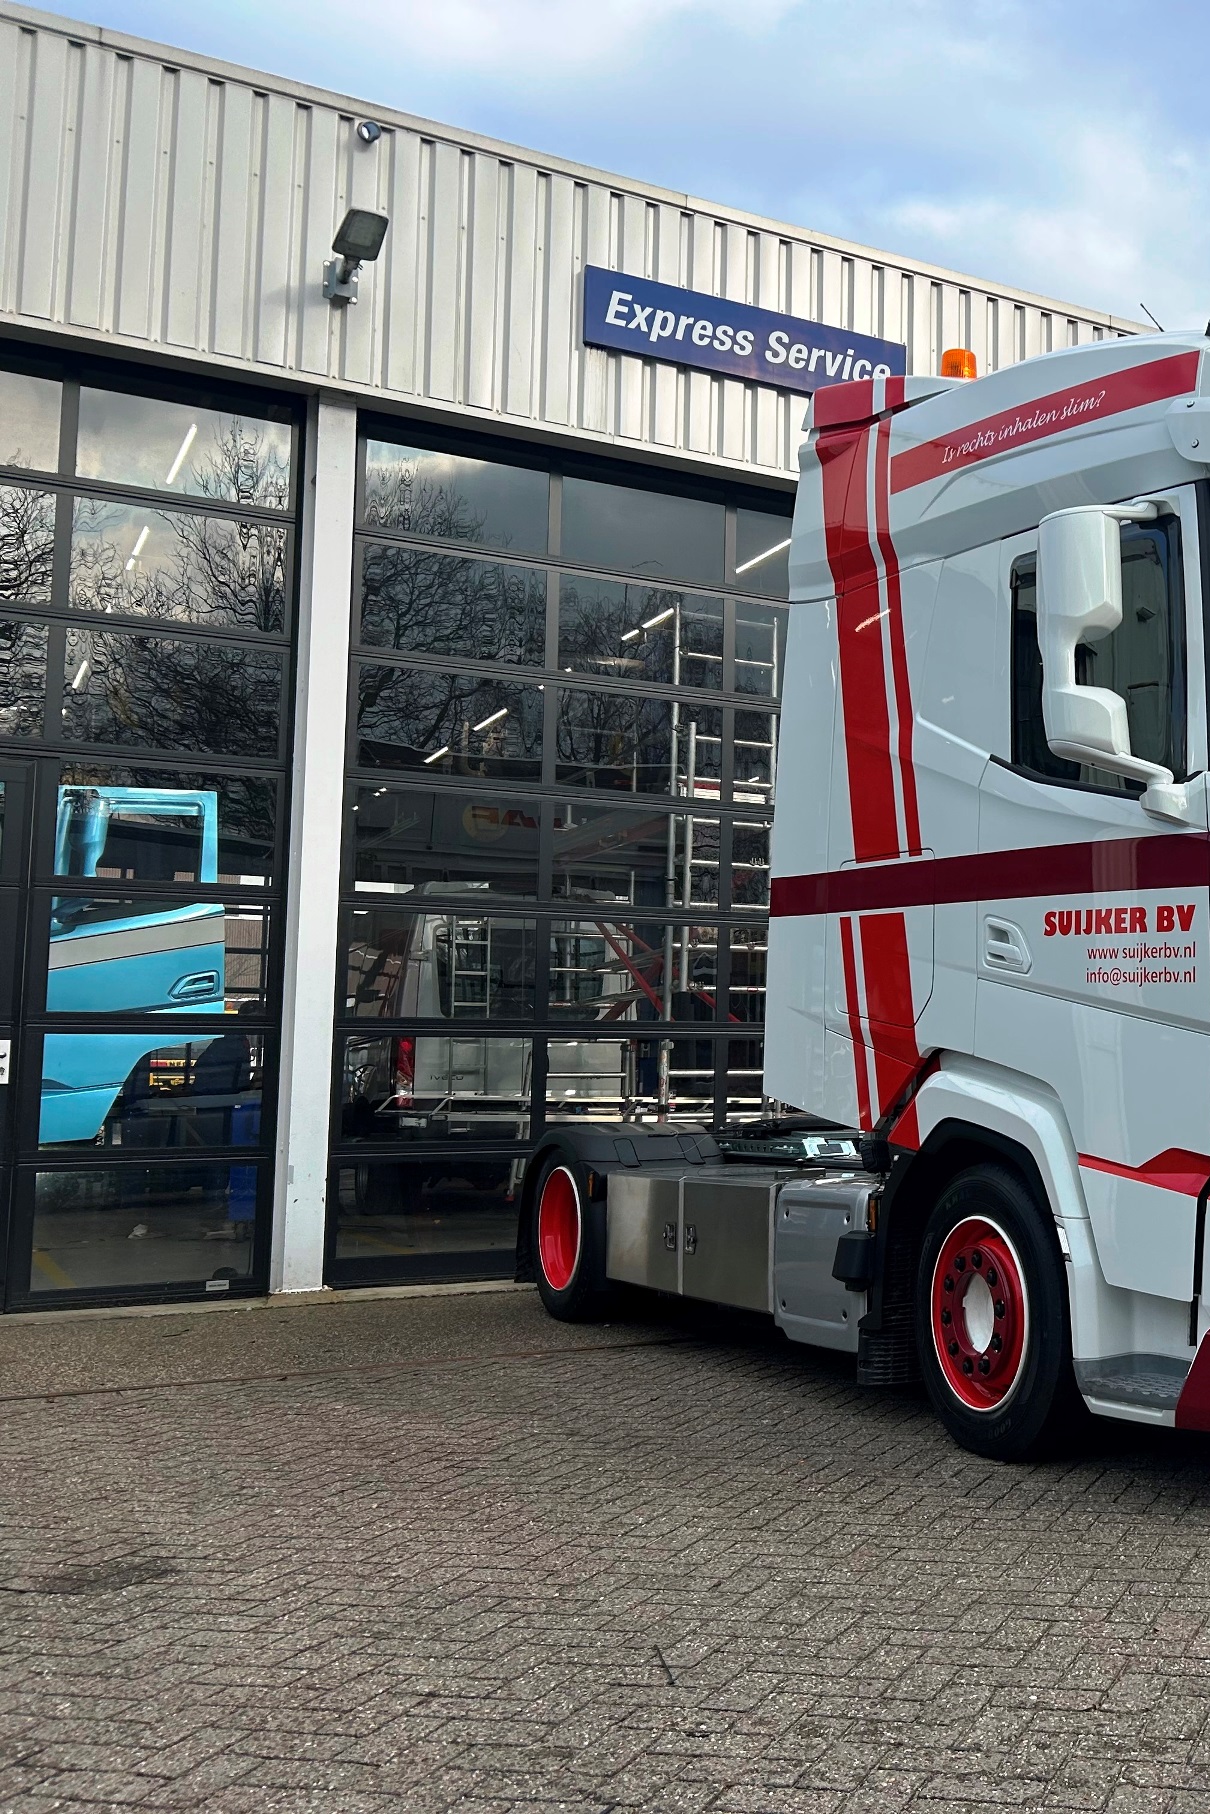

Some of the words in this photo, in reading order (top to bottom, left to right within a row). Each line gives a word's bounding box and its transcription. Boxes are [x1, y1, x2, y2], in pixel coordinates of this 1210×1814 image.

[604, 290, 755, 357] Express
[764, 330, 892, 380] Service
[941, 446, 956, 465] Is
[955, 430, 997, 458] rechts
[998, 410, 1061, 441] inhalen
[1060, 389, 1106, 420] slim?
[1043, 906, 1148, 937] SUIJKER
[1156, 904, 1196, 933] BV
[1086, 966, 1197, 988] info@suijkerbv.nl
